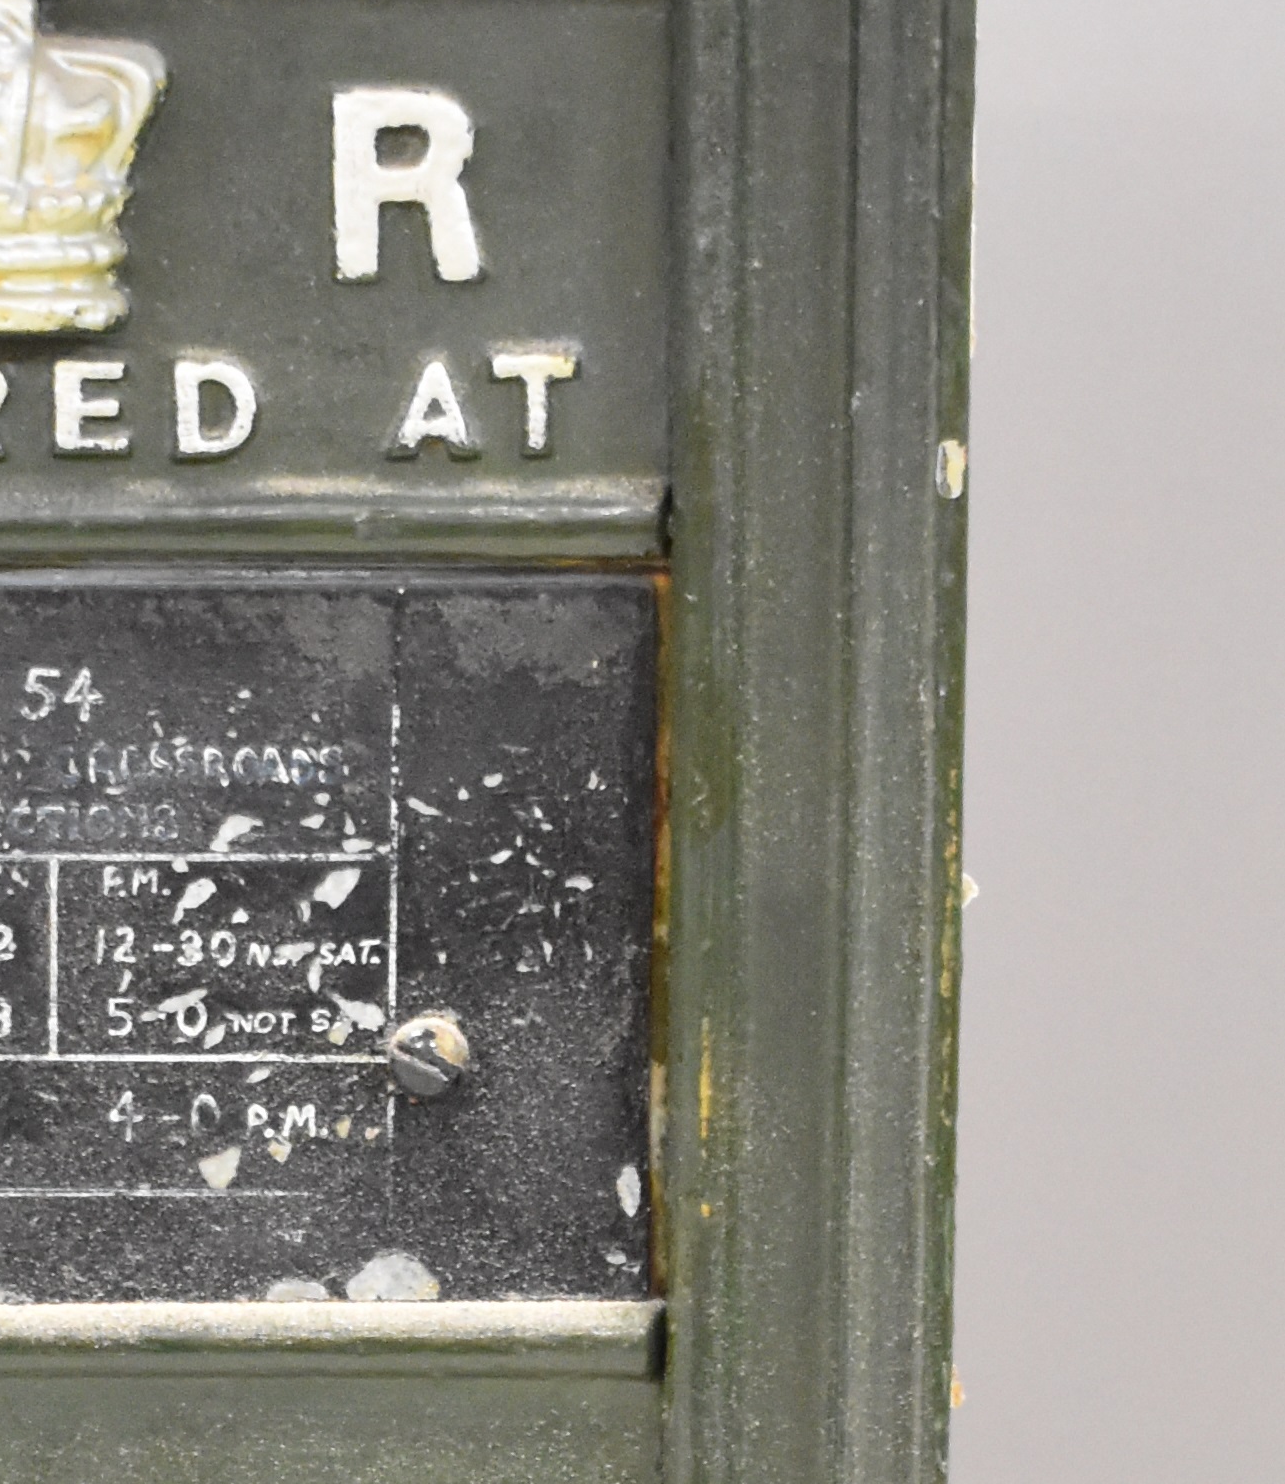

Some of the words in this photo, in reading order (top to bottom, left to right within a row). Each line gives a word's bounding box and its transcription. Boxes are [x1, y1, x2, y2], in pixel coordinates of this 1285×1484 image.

[332, 85, 484, 284] R
[390, 352, 576, 457] AT
[20, 667, 105, 722] 54
[319, 938, 382, 967] SAT.
